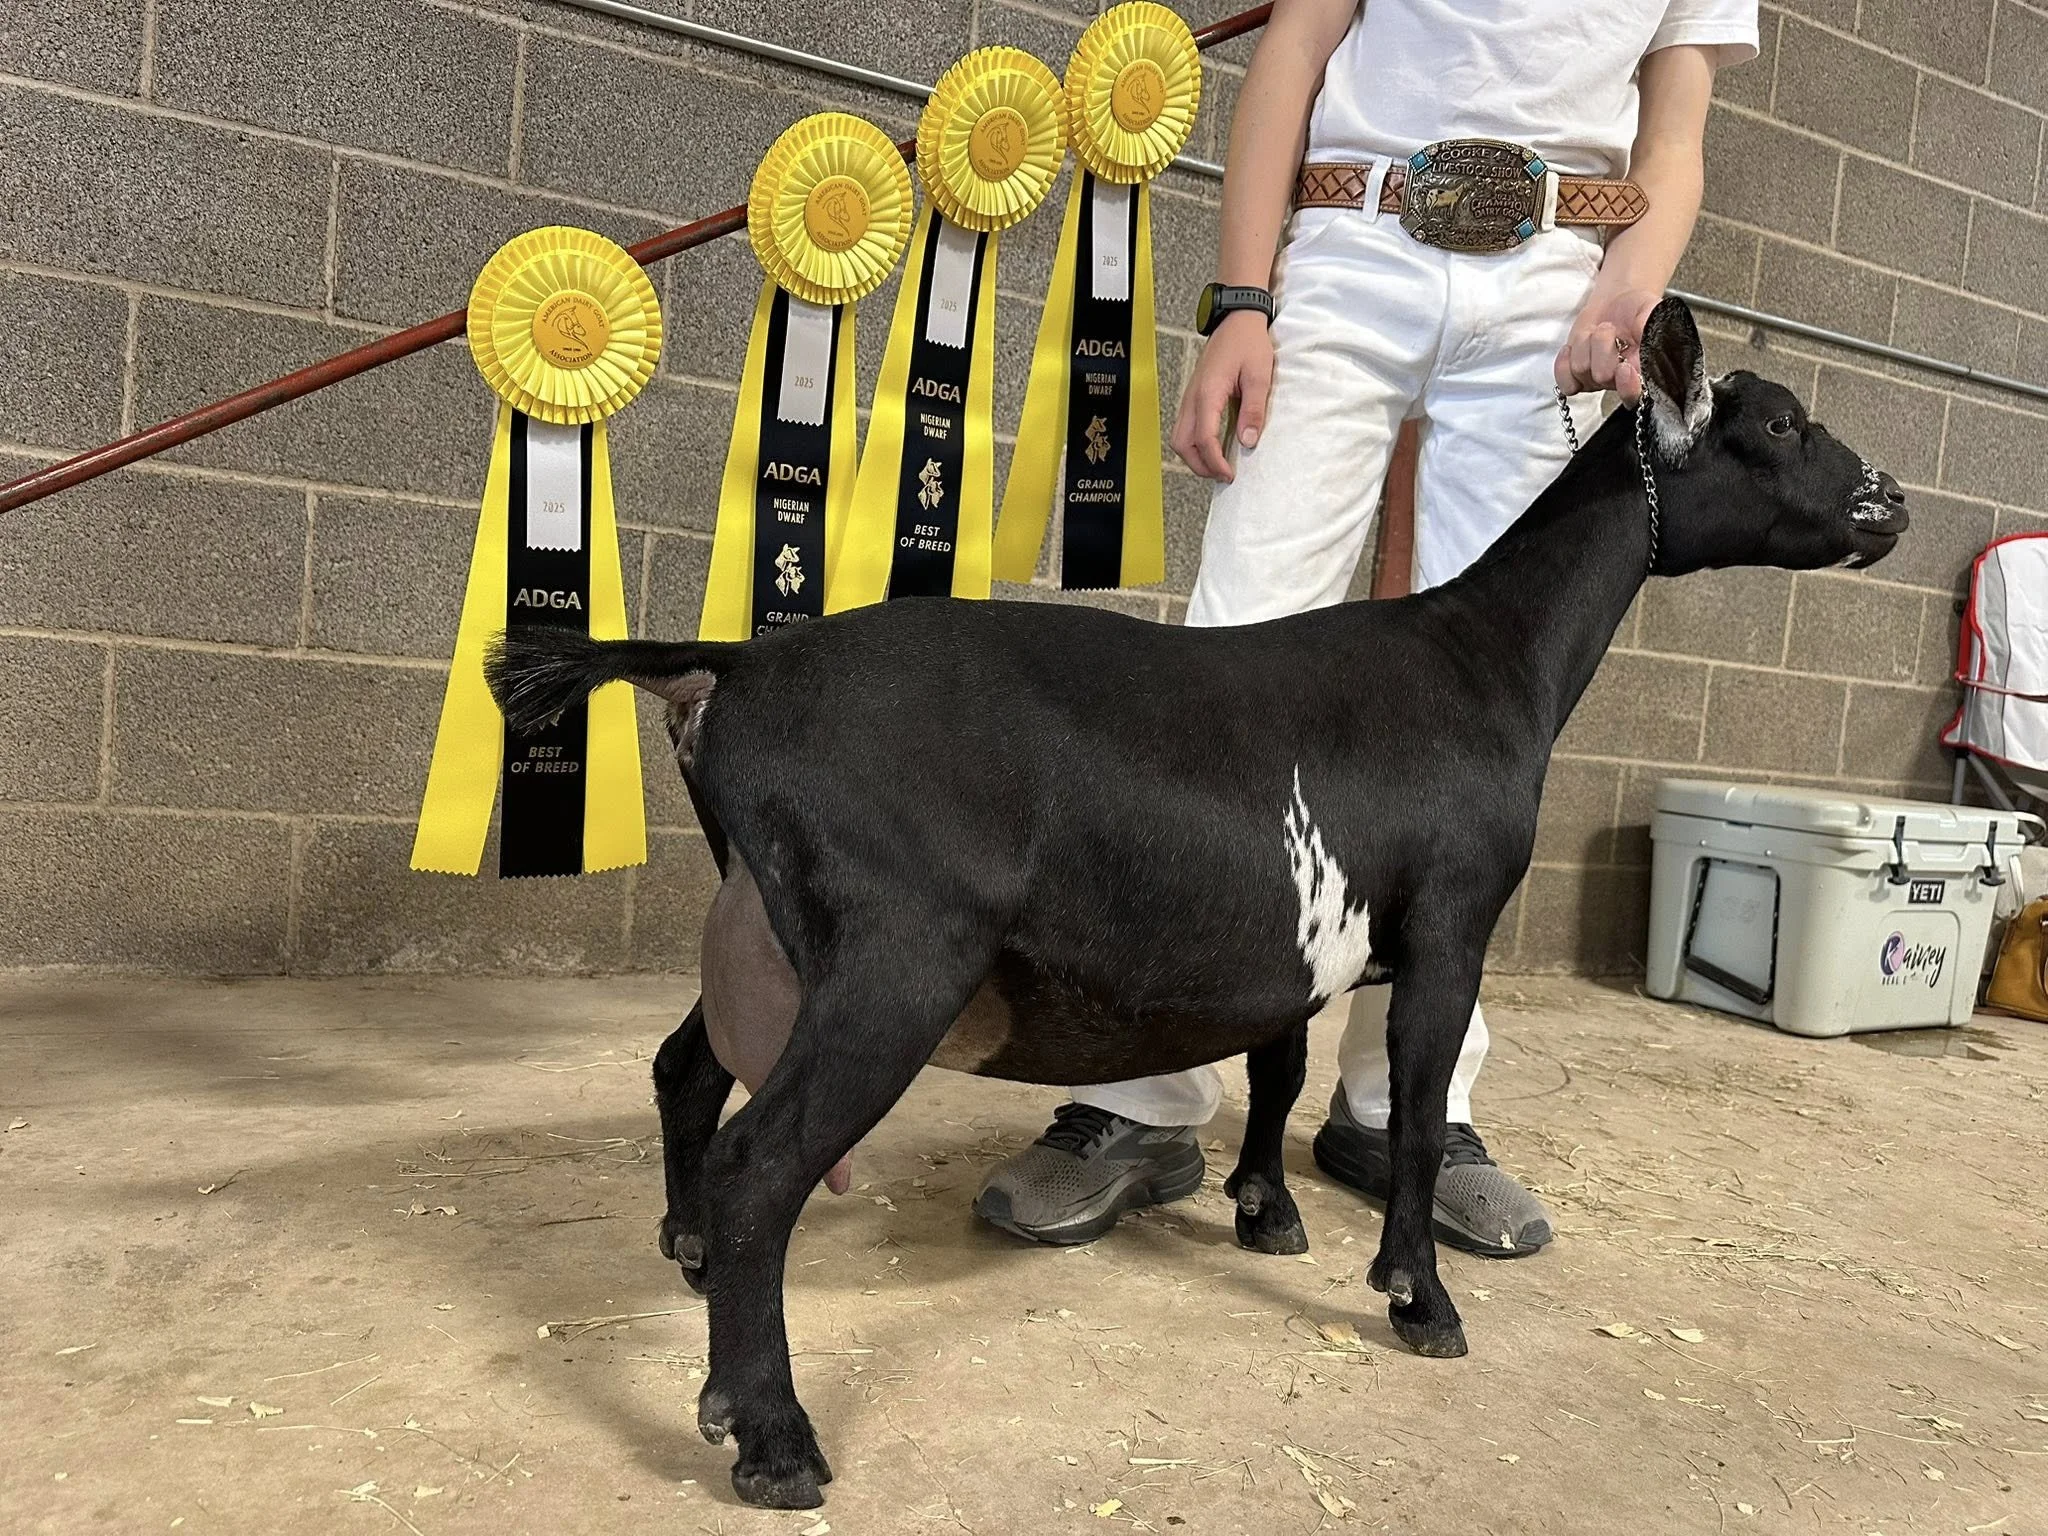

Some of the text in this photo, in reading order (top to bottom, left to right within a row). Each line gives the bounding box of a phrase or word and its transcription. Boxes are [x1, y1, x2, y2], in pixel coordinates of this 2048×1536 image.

[1441, 147, 1490, 161] COOKE
[1432, 162, 1522, 179] LIVESTOCK SHOW
[1102, 255, 1119, 267] 2025
[542, 297, 605, 329] AMERICAN DAIRY GOAT
[940, 298, 957, 313] 2025
[1075, 338, 1126, 359] ADGA
[549, 349, 594, 364] ASSOCIATION
[794, 375, 815, 389] 2025
[1085, 372, 1117, 385] NIGERIAN
[911, 376, 961, 404] ADGA
[1088, 384, 1114, 396] DWARF
[920, 412, 951, 429] NIGERIAN
[923, 425, 948, 440] DWARF
[763, 461, 822, 486] ADGA
[1077, 478, 1114, 491] GRAND
[773, 497, 810, 513] NIGERIAN
[1068, 491, 1121, 504] CHAMPION
[542, 501, 566, 514] 2025
[777, 510, 806, 525] DWARF
[914, 523, 941, 538] BEST
[900, 535, 952, 553] OF BREED
[513, 587, 582, 610] ADGA
[766, 611, 809, 623] GRAND
[528, 746, 563, 759] BEST
[510, 761, 580, 774] OF BREED
[1911, 883, 1943, 901] YETI
